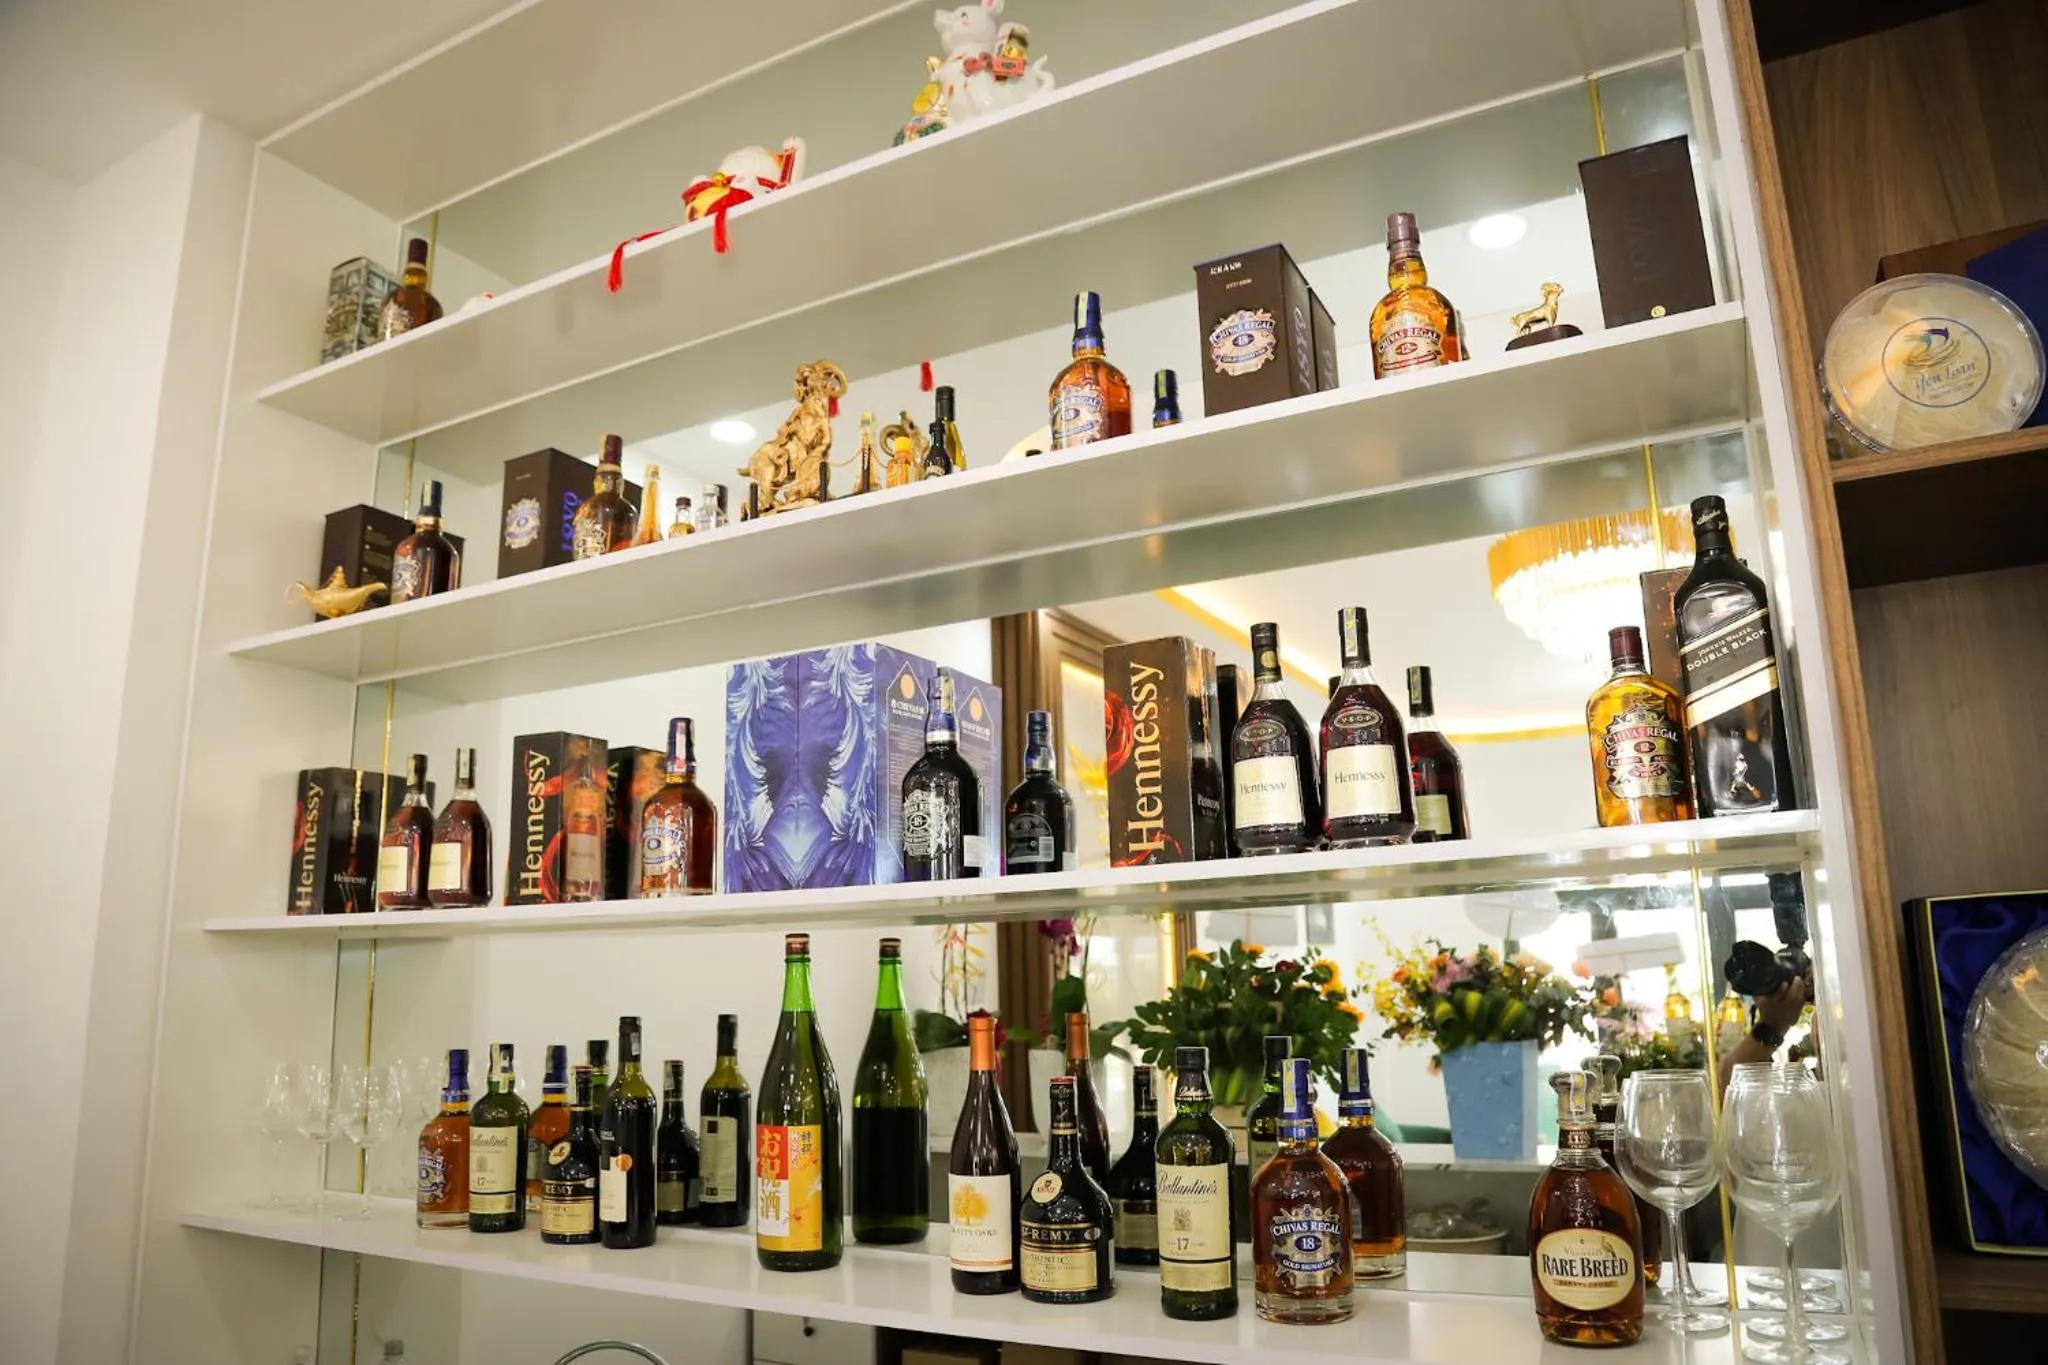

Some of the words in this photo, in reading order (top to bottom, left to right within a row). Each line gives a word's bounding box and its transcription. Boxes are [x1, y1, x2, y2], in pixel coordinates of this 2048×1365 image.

[1407, 328, 1439, 340] REGAL
[1686, 646, 1729, 671] DOUBLE
[1732, 629, 1768, 651] BLACK
[1647, 727, 1679, 742] REGAL
[1127, 661, 1165, 853] Hennessy
[1334, 770, 1385, 784] Hennessy
[1240, 781, 1287, 795] Hennessy
[520, 750, 550, 896] Hennessy
[296, 782, 323, 908] Hennessy
[1157, 1171, 1218, 1197] Ballantine's
[1273, 1221, 1309, 1237] CHIVAS
[1311, 1221, 1341, 1235] REGAL
[1177, 1237, 1189, 1250] 17
[1302, 1237, 1316, 1250] 18
[1282, 1259, 1300, 1269] GOLD
[1300, 1258, 1335, 1271] SIGNATURE
[1542, 1254, 1579, 1277] RARE
[1580, 1257, 1629, 1278] BREED
